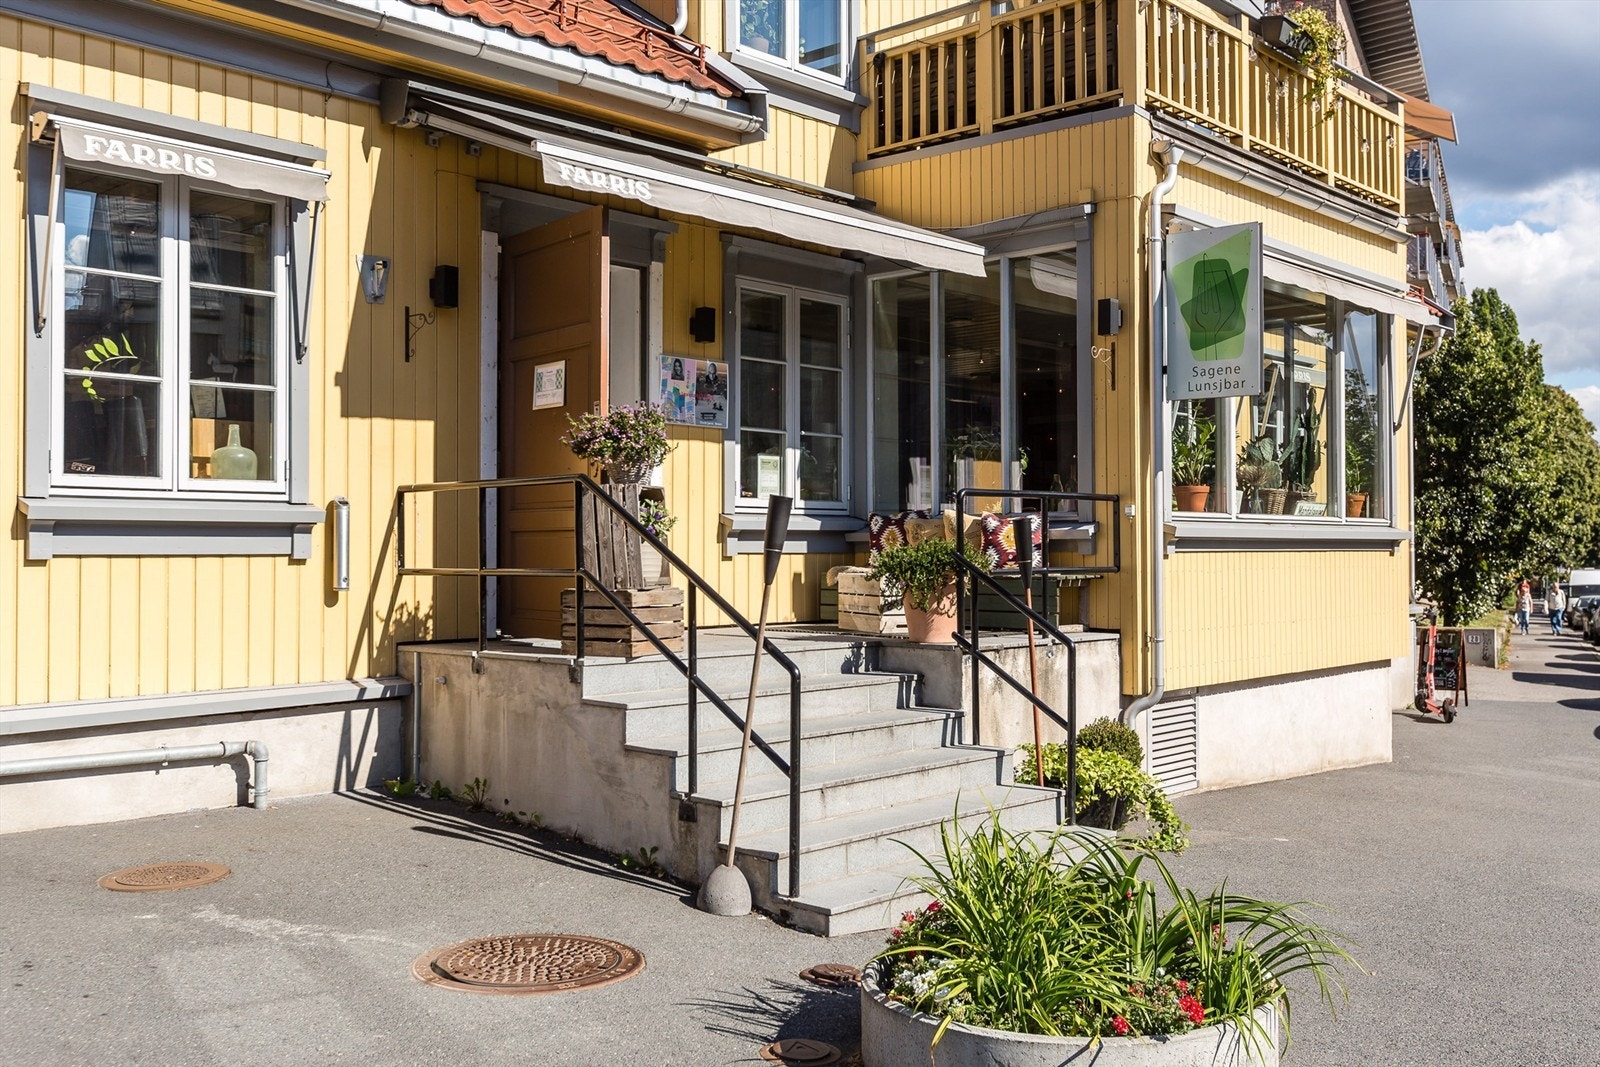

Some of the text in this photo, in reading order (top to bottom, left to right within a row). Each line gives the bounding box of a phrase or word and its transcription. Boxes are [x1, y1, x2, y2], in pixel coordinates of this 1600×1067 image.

[83, 134, 217, 178] FARRIS
[558, 162, 652, 200] FARRIS
[1192, 365, 1241, 379] Sagene
[1187, 378, 1246, 393] Lunsjbar
